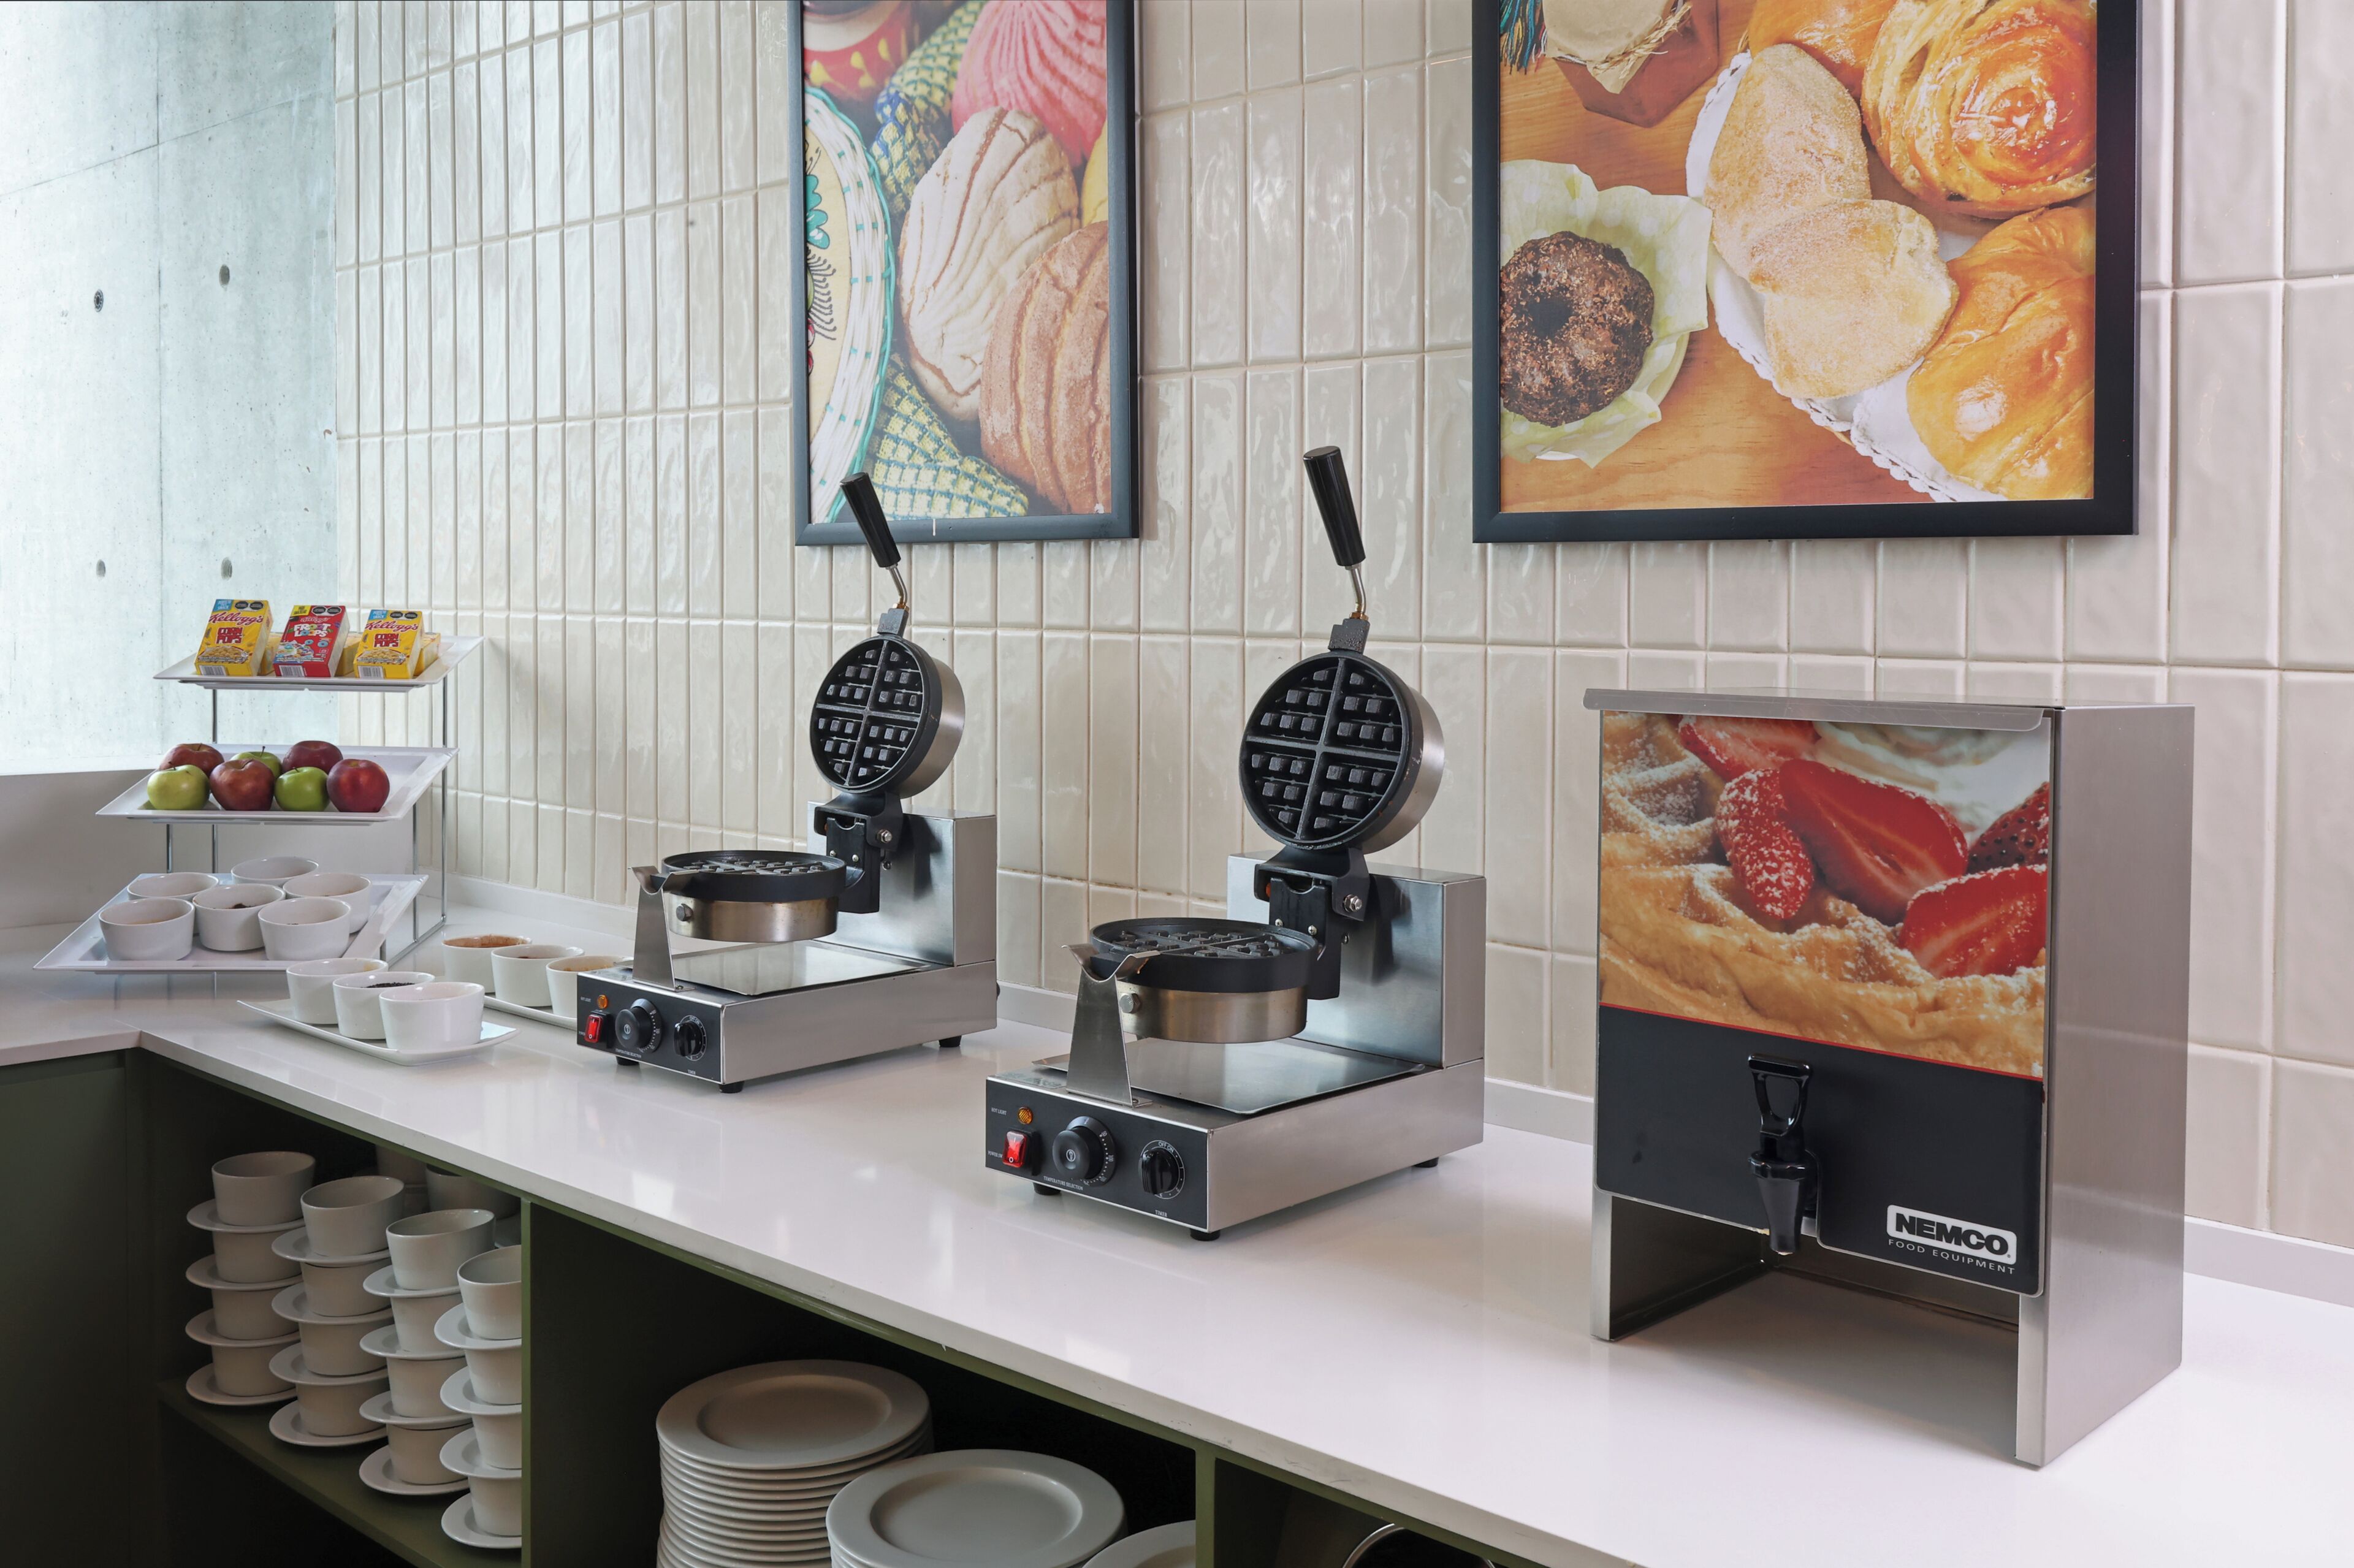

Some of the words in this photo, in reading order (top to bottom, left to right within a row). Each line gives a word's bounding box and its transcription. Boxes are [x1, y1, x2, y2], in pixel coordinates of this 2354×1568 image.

[208, 612, 264, 626] Kellogg's
[364, 620, 418, 632] Kellogg's
[216, 635, 243, 644] POPS
[1043, 1176, 1065, 1186] TEMPERATURE
[1896, 1213, 2009, 1255] NEMCO
[1888, 1239, 1925, 1253] FOOD
[1932, 1249, 2016, 1274] EQUIPMENT
